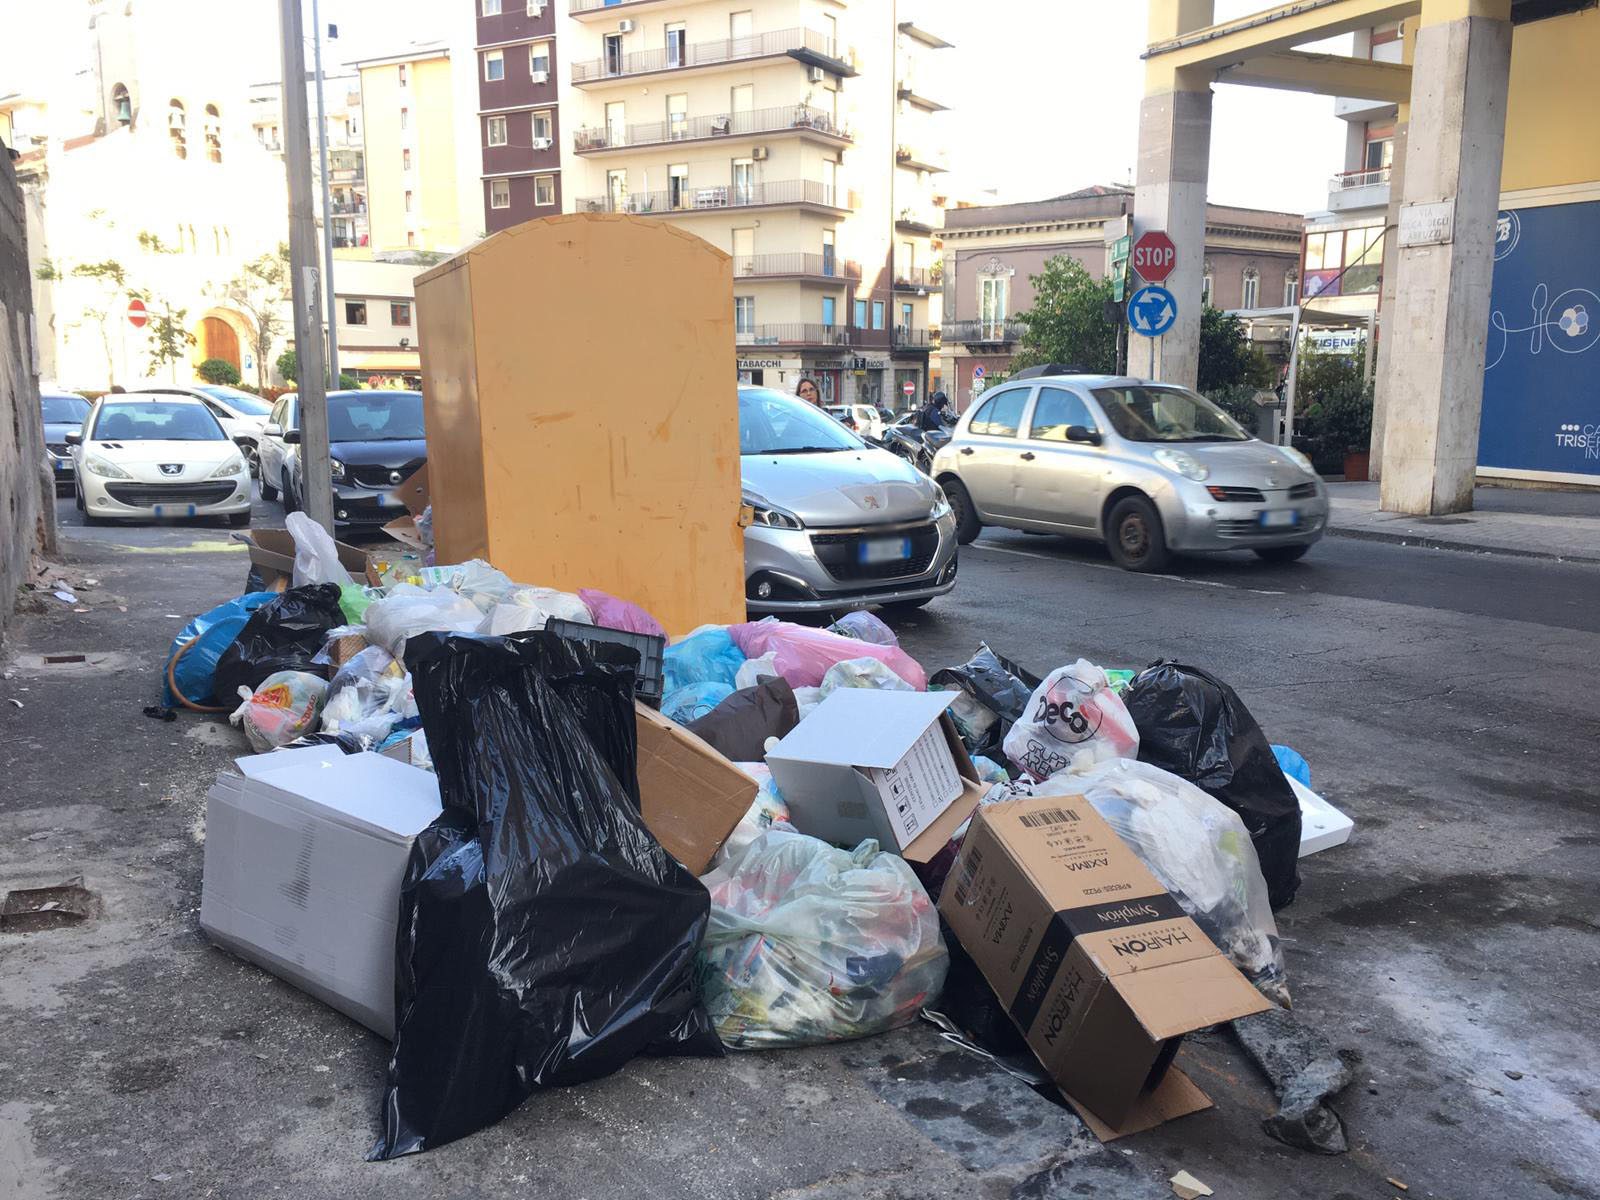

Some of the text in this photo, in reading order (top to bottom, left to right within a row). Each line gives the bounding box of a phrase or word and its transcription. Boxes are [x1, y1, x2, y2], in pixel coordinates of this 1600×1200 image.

[1136, 247, 1174, 266] STOP
[739, 360, 781, 368] TABACCHI
[1555, 434, 1587, 448] TRIS
[301, 694, 317, 724] CONAD
[1027, 738, 1071, 768] GRUPP
[1065, 857, 1109, 872] AXIMA
[992, 902, 1014, 945] AXIMA
